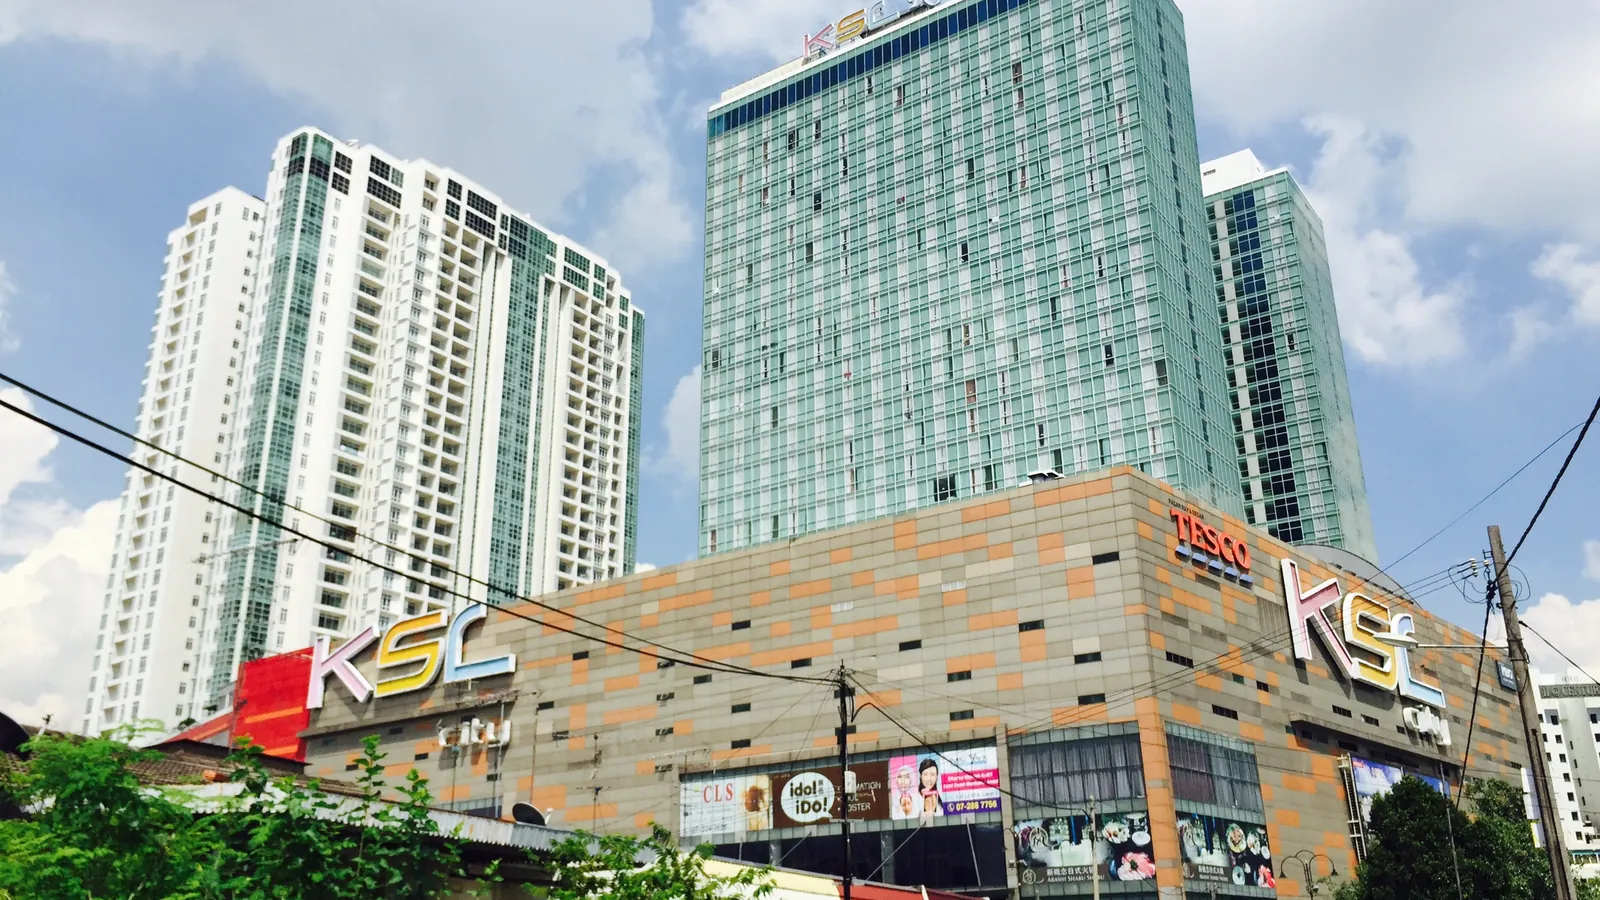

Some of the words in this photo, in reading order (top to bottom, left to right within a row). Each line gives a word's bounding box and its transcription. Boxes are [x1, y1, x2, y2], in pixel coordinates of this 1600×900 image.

[803, 0, 900, 58] KSL
[1170, 508, 1251, 569] TESCO
[1281, 558, 1446, 708] KSL
[306, 603, 516, 709] KSL
[1561, 684, 1600, 697] CENTUR
[437, 718, 511, 749] city
[703, 783, 733, 803] CLS
[796, 796, 828, 815] iDO!
[848, 802, 871, 812] OSTER
